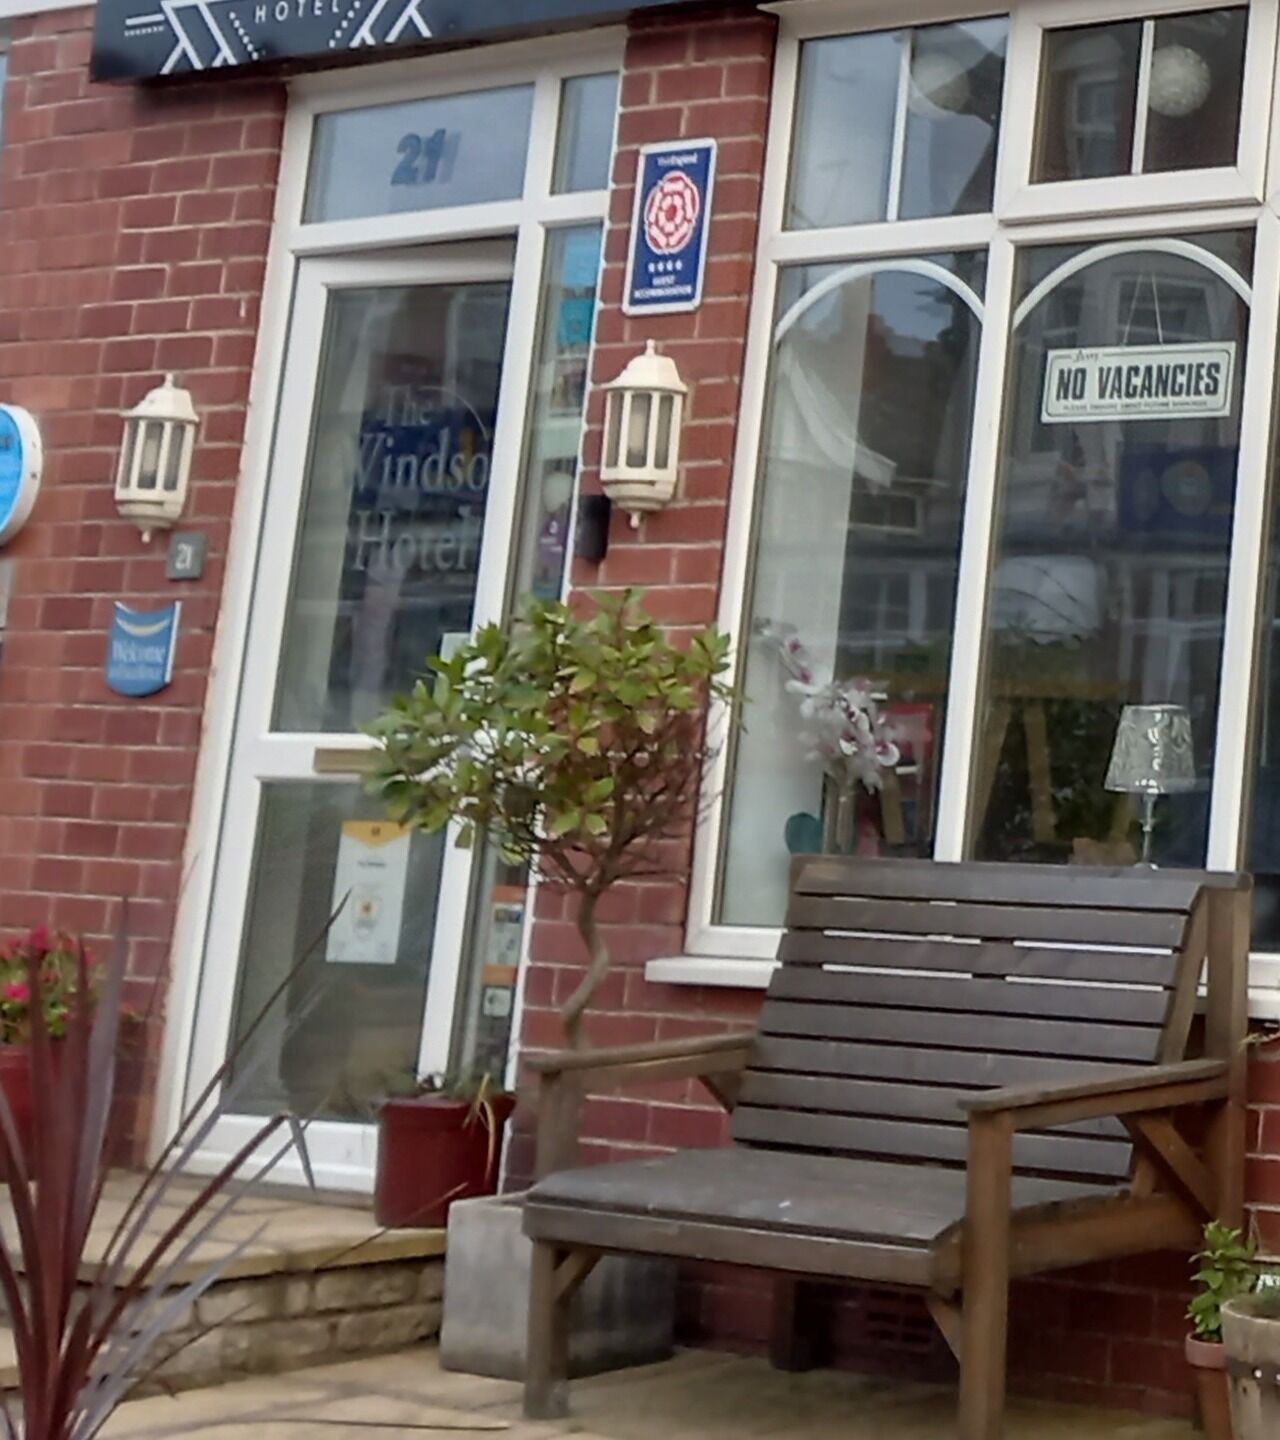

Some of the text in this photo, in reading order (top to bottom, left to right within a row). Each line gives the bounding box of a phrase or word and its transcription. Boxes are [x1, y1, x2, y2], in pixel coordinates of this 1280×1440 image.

[1056, 362, 1221, 401] NO VACANCIES
[345, 427, 488, 494] Windso
